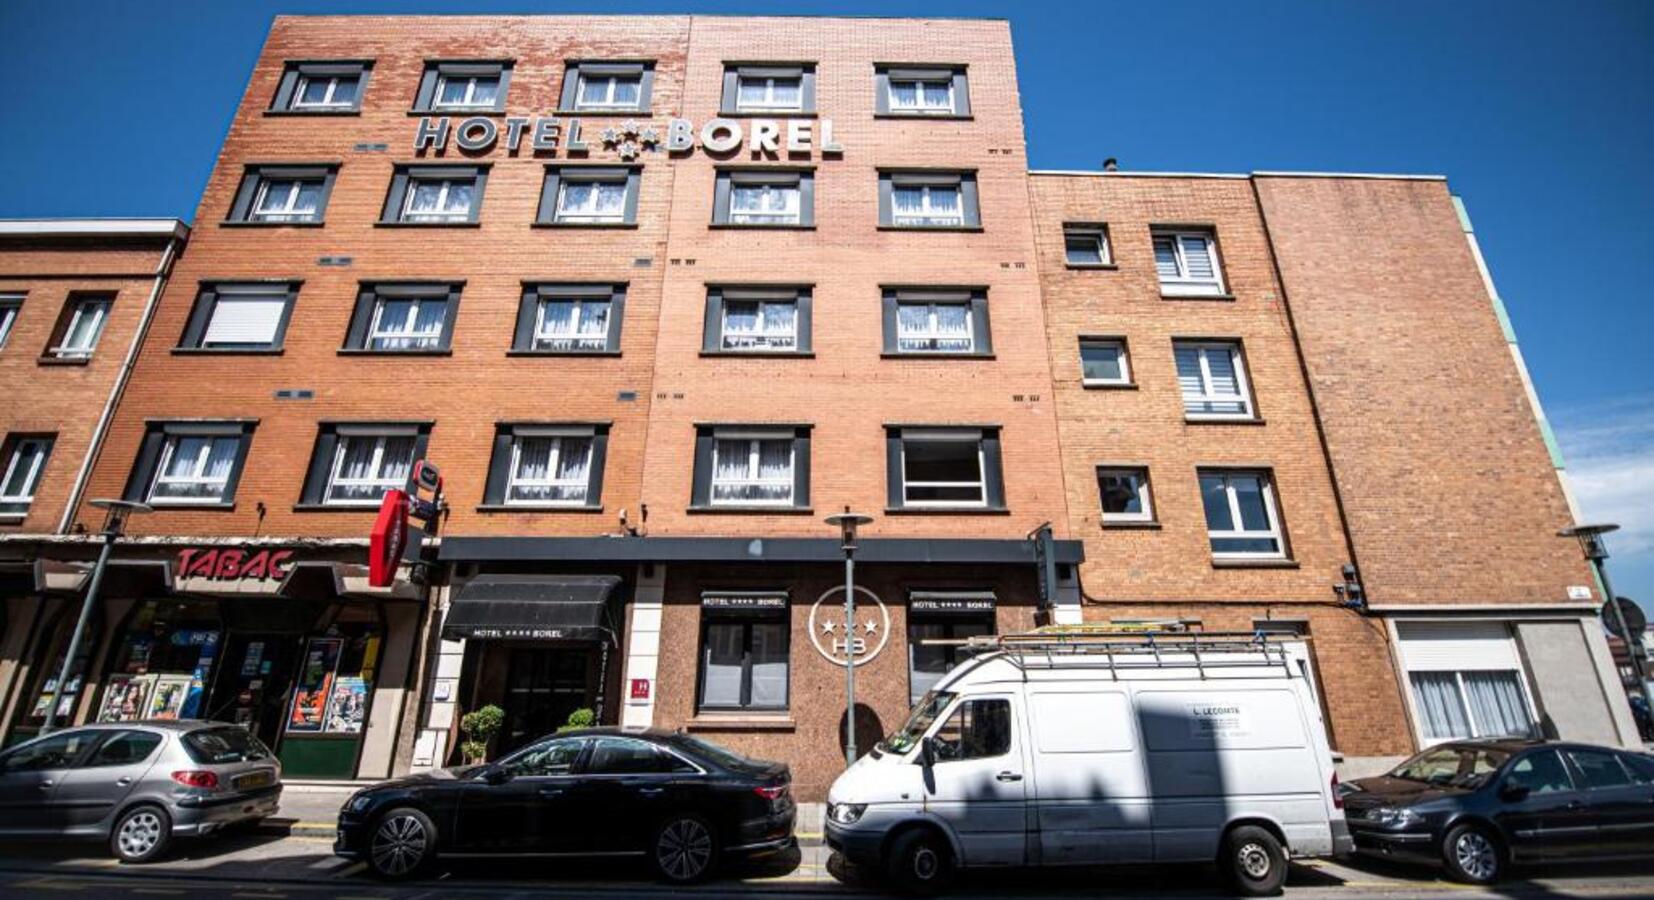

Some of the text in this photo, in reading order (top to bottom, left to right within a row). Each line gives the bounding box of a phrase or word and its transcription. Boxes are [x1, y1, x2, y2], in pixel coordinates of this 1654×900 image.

[414, 116, 845, 158] HOTEL BOREL
[178, 548, 295, 579] TABAC
[703, 598, 785, 606] HOTEL BOREL
[912, 601, 994, 609] HOTEL BOREL
[473, 629, 563, 638] HOTEL BOREL
[832, 638, 866, 655] HB
[639, 681, 648, 691] H
